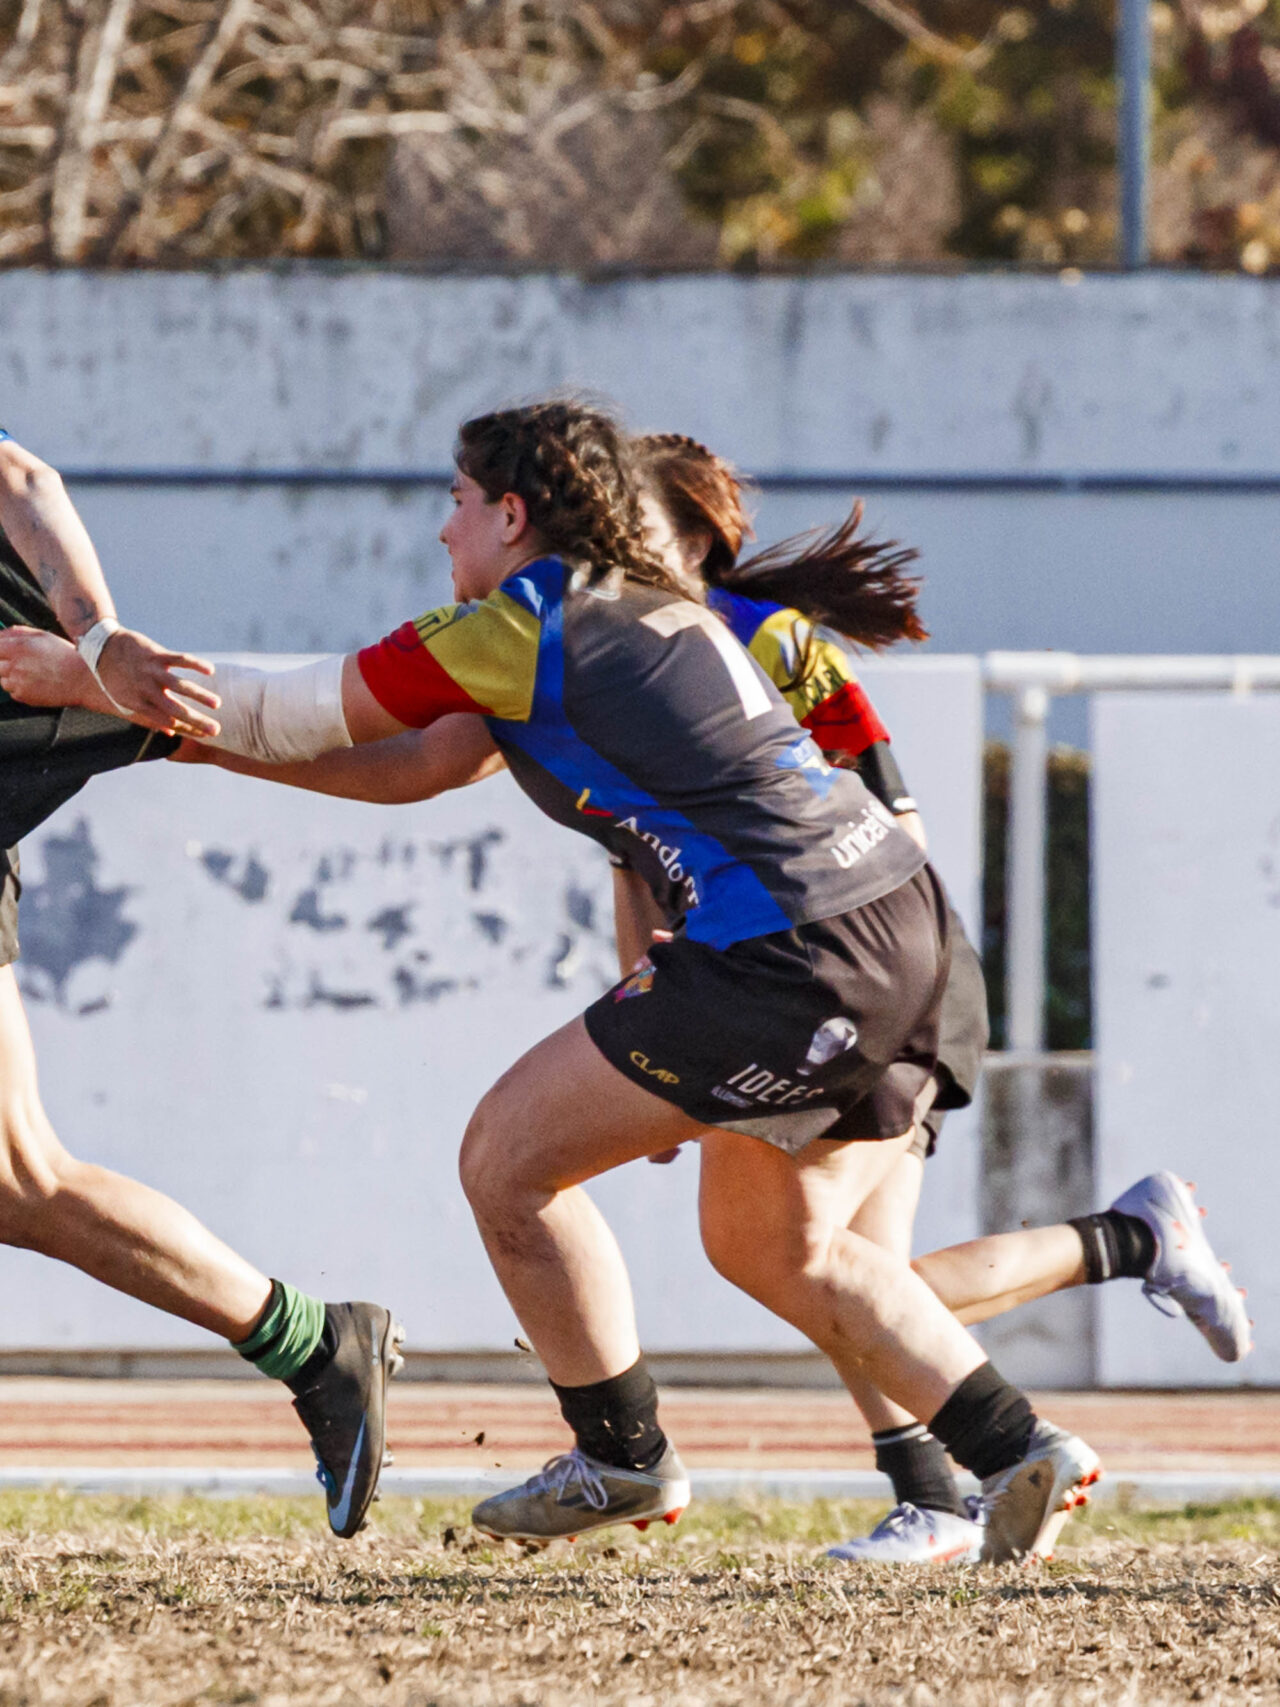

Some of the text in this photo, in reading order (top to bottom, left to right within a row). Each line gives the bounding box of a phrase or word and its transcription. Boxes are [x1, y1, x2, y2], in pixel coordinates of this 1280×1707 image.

[614, 816, 700, 906] Andorr
[830, 807, 890, 869] unicef
[629, 1050, 680, 1084] CLAP
